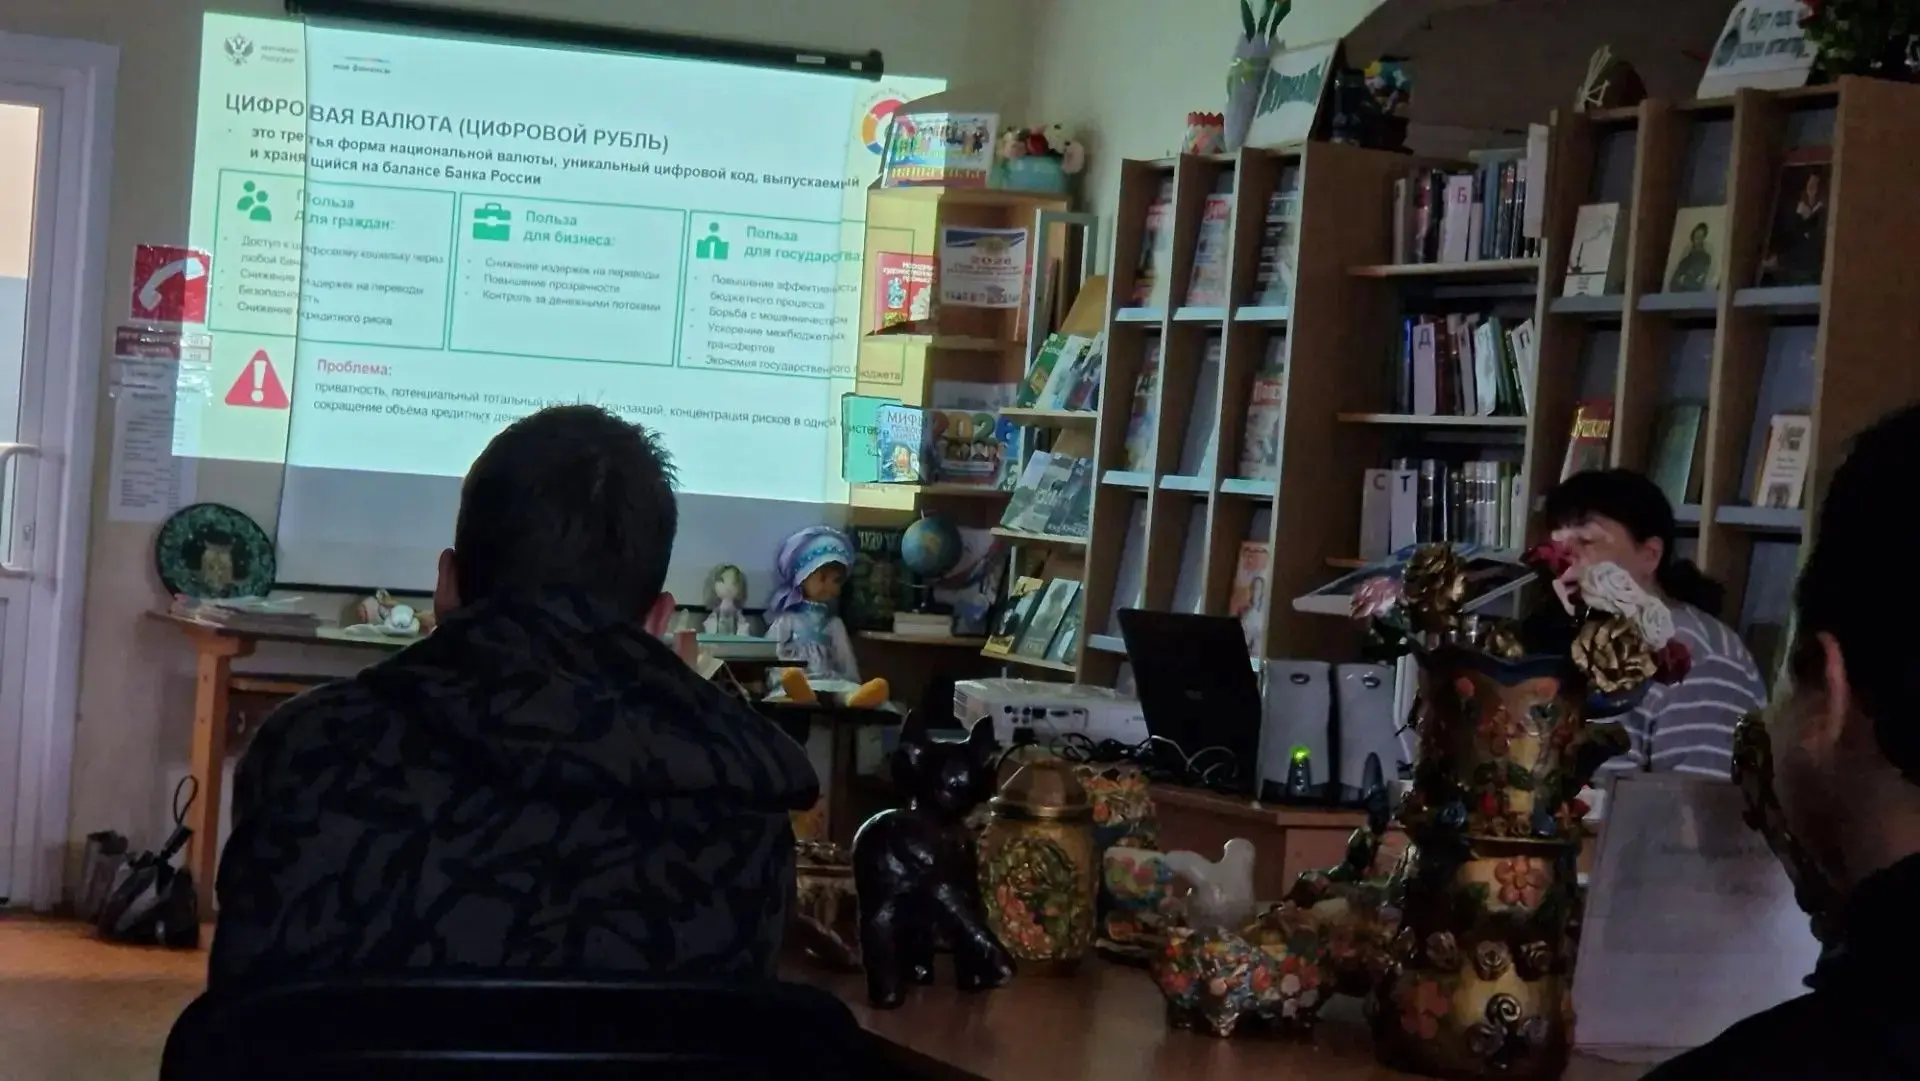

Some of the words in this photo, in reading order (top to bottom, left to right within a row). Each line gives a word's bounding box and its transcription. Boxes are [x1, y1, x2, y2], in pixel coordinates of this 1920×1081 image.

[226, 93, 354, 125] ЦИФРОВАЯ
[361, 110, 452, 134] ВАЛЮТА
[459, 121, 587, 146] (ЦИФРОВОЙ
[594, 129, 669, 155] РУБЛЬ)
[250, 149, 258, 158] и
[263, 149, 359, 172] хранящийся
[362, 162, 379, 172] на
[383, 162, 440, 178] балансе
[445, 165, 487, 182] Банка
[490, 169, 541, 185] России
[252, 129, 275, 140] это
[280, 131, 334, 149] третья
[337, 137, 386, 154] форма
[390, 143, 493, 163] национальной
[497, 151, 558, 168] валюты,
[563, 157, 650, 175] уникальный
[654, 163, 726, 183] цифровой
[730, 169, 759, 185] код,
[763, 173, 860, 189] выпускаемый
[1457, 186, 1467, 204] Б
[333, 214, 395, 232] граждан:
[525, 210, 577, 226] Польза
[522, 231, 550, 243] для
[554, 231, 615, 247] бизнеса:
[746, 225, 798, 242] Польза
[241, 236, 281, 251] Доступ
[744, 245, 772, 258] для
[485, 257, 538, 271] Снижение
[541, 264, 590, 277] издержек
[593, 267, 606, 276] на
[608, 268, 660, 281] переводы
[484, 273, 546, 288] Повышение
[549, 280, 620, 294] прозрачности
[712, 274, 774, 289] Повышение
[483, 290, 532, 303] Контроль
[535, 295, 546, 304] за
[612, 299, 661, 311] потоками
[775, 297, 825, 312] процесса
[709, 306, 748, 319] Борьба
[708, 323, 763, 338] Ускорение
[1418, 329, 1431, 350] Д
[1518, 329, 1530, 349] П
[317, 359, 393, 377] Проблема:
[705, 354, 756, 367] Экономия
[314, 400, 382, 415] сокращение
[385, 402, 428, 417] объёма
[432, 407, 490, 422] кредитных
[315, 382, 389, 398] приватность,
[391, 386, 479, 403] потенциальный
[670, 407, 748, 423] концентрация
[751, 413, 791, 427] рисков
[794, 417, 801, 426] в
[803, 416, 836, 430] одной
[1373, 473, 1386, 490] С
[1399, 475, 1411, 492] Т
